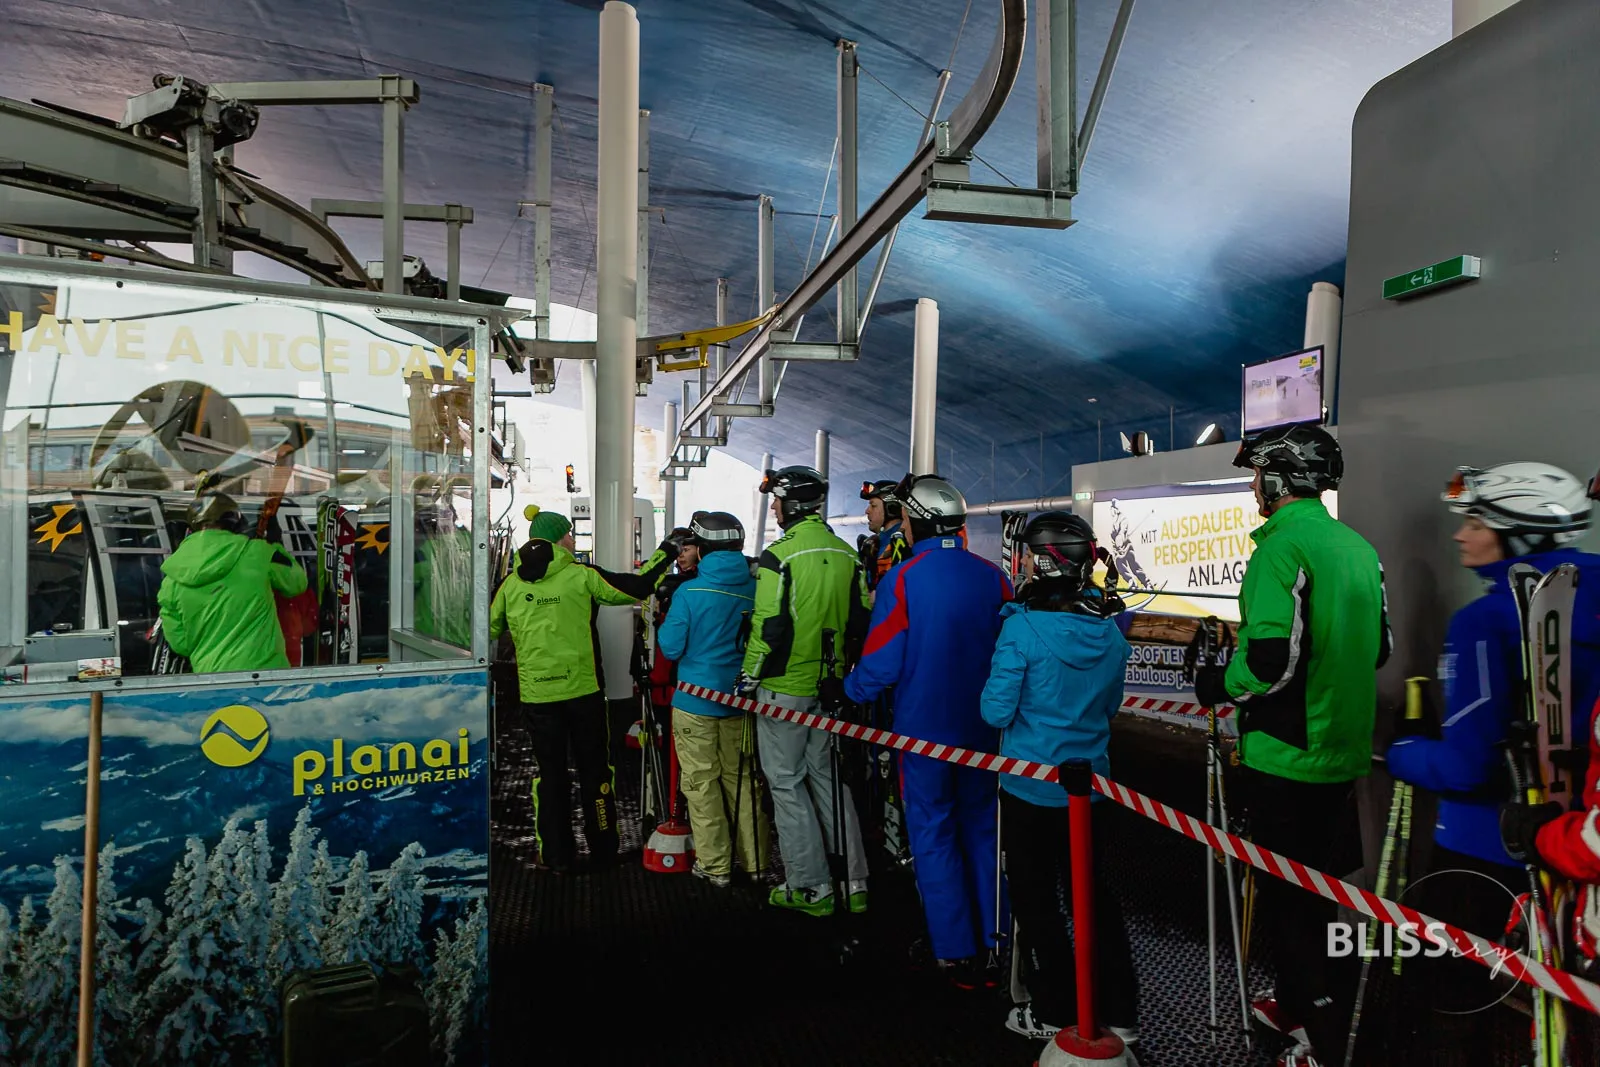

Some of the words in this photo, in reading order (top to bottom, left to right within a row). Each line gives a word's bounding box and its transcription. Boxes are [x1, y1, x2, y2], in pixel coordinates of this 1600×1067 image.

[166, 325, 203, 364] A
[223, 330, 349, 374] NICE
[368, 343, 475, 382] DAY!
[1141, 530, 1157, 544] MIT
[1161, 506, 1244, 541] AUSDAUER
[1188, 560, 1248, 587] ANLAG
[1125, 664, 1175, 685] abulous
[293, 728, 469, 796] planai
[313, 783, 325, 795] &
[332, 767, 470, 793] HOCHWURZEN
